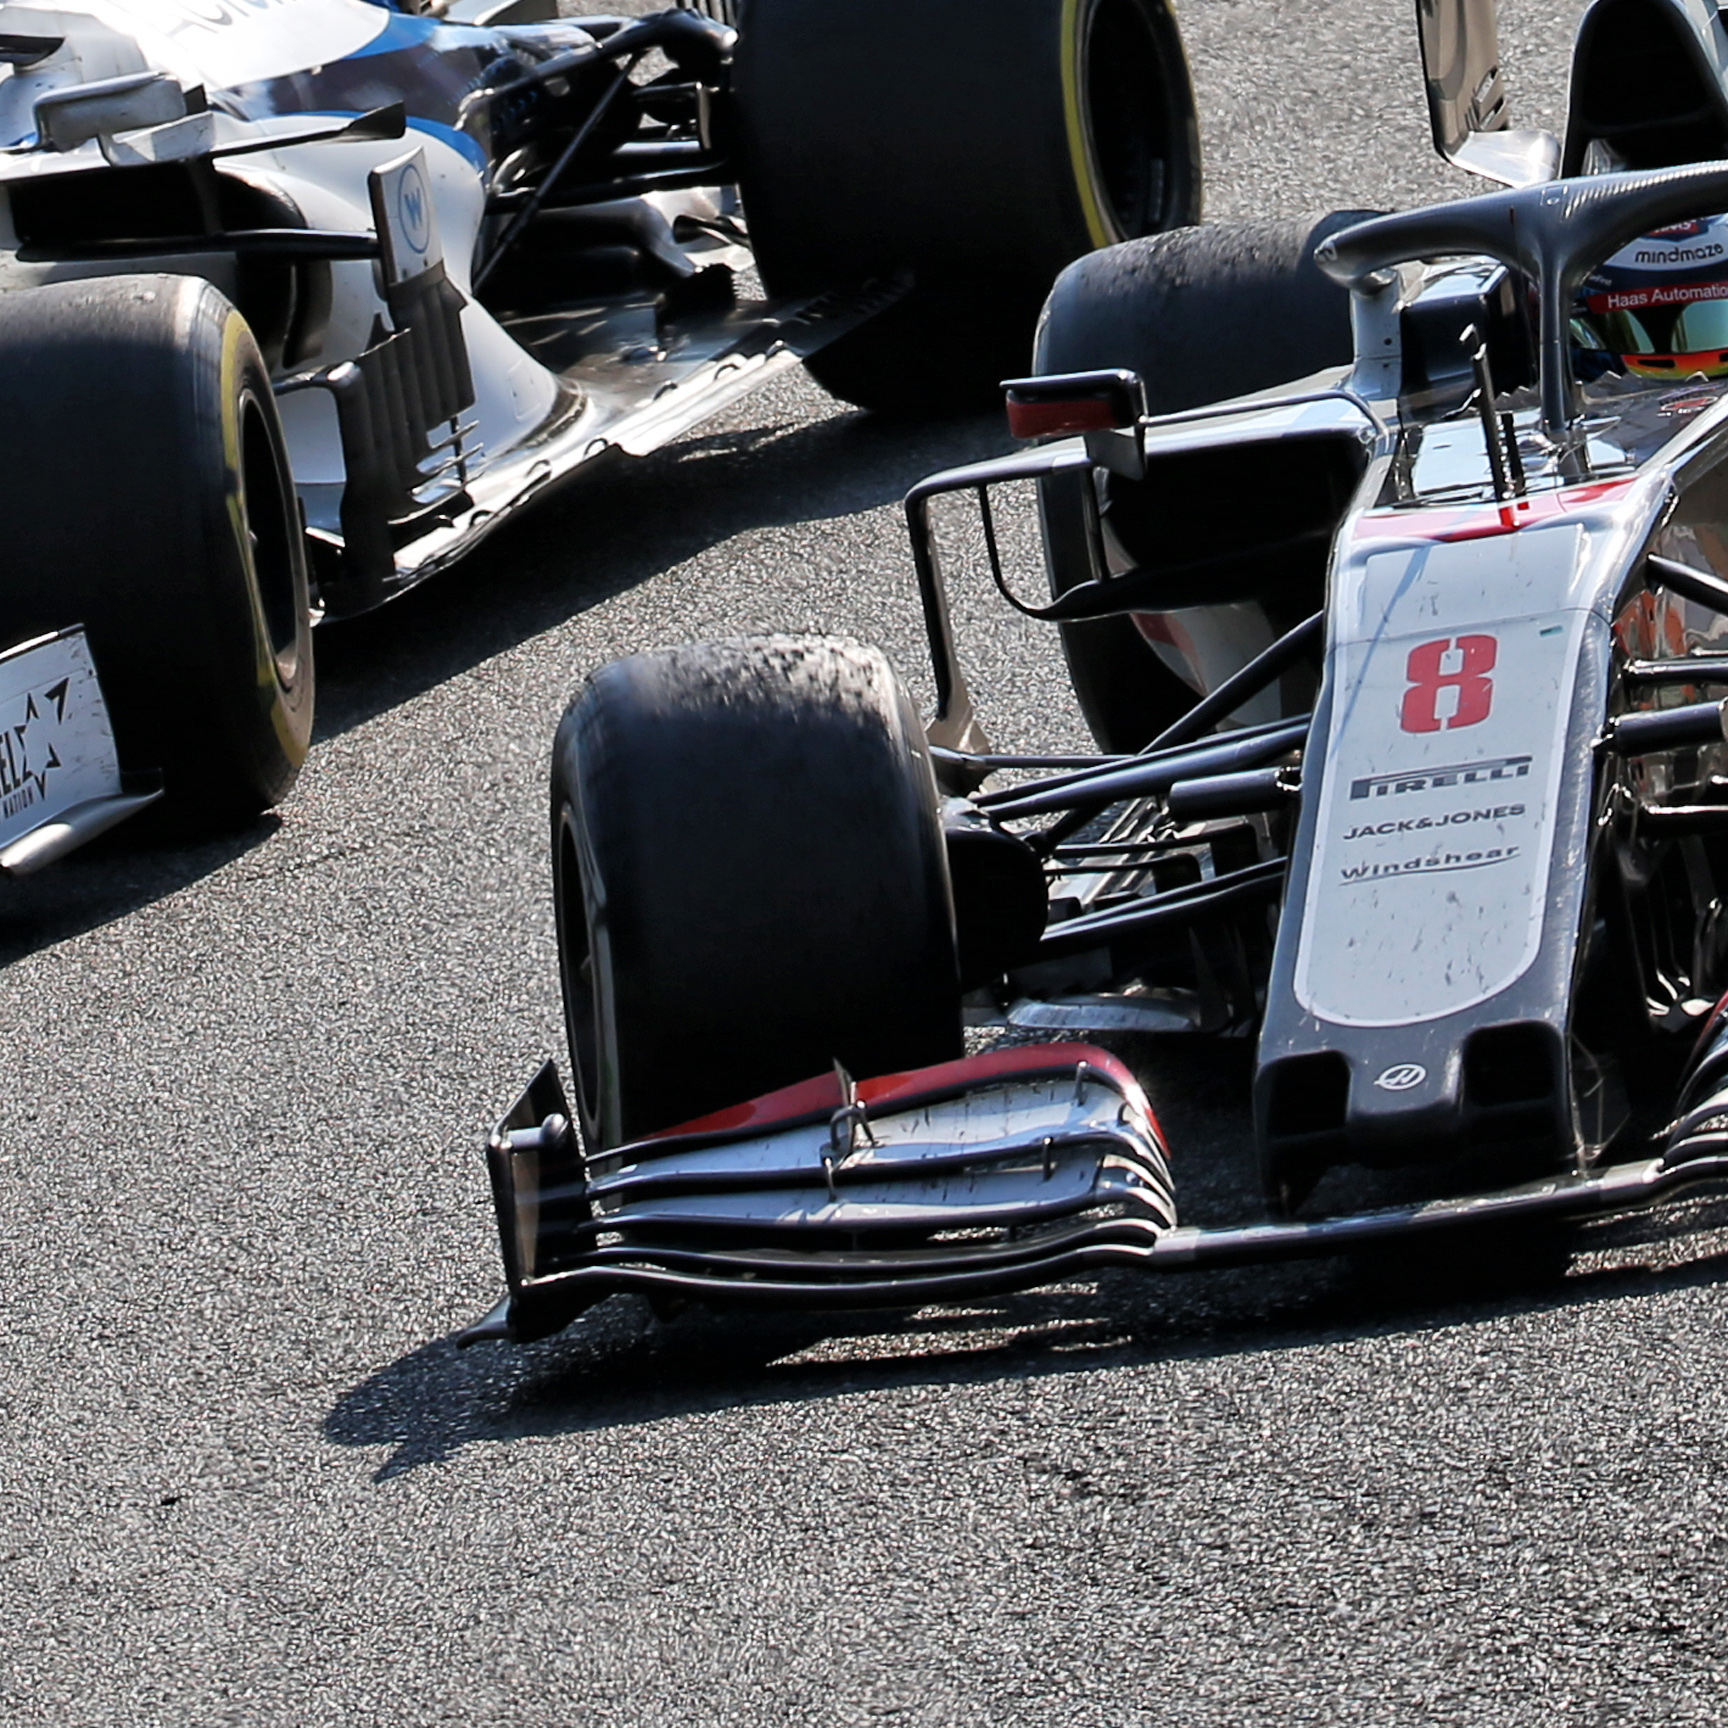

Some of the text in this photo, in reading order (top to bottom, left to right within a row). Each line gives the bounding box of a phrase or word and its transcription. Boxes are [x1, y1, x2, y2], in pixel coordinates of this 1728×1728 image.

[1634, 242, 1724, 264] mindmaze
[1607, 293, 1648, 309] Haas
[1400, 633, 1498, 734] 8
[1349, 755, 1533, 801] PIRELLI
[3, 785, 35, 820] NATION
[1343, 803, 1526, 840] JACK&JONES
[1340, 845, 1520, 880] Windshear
